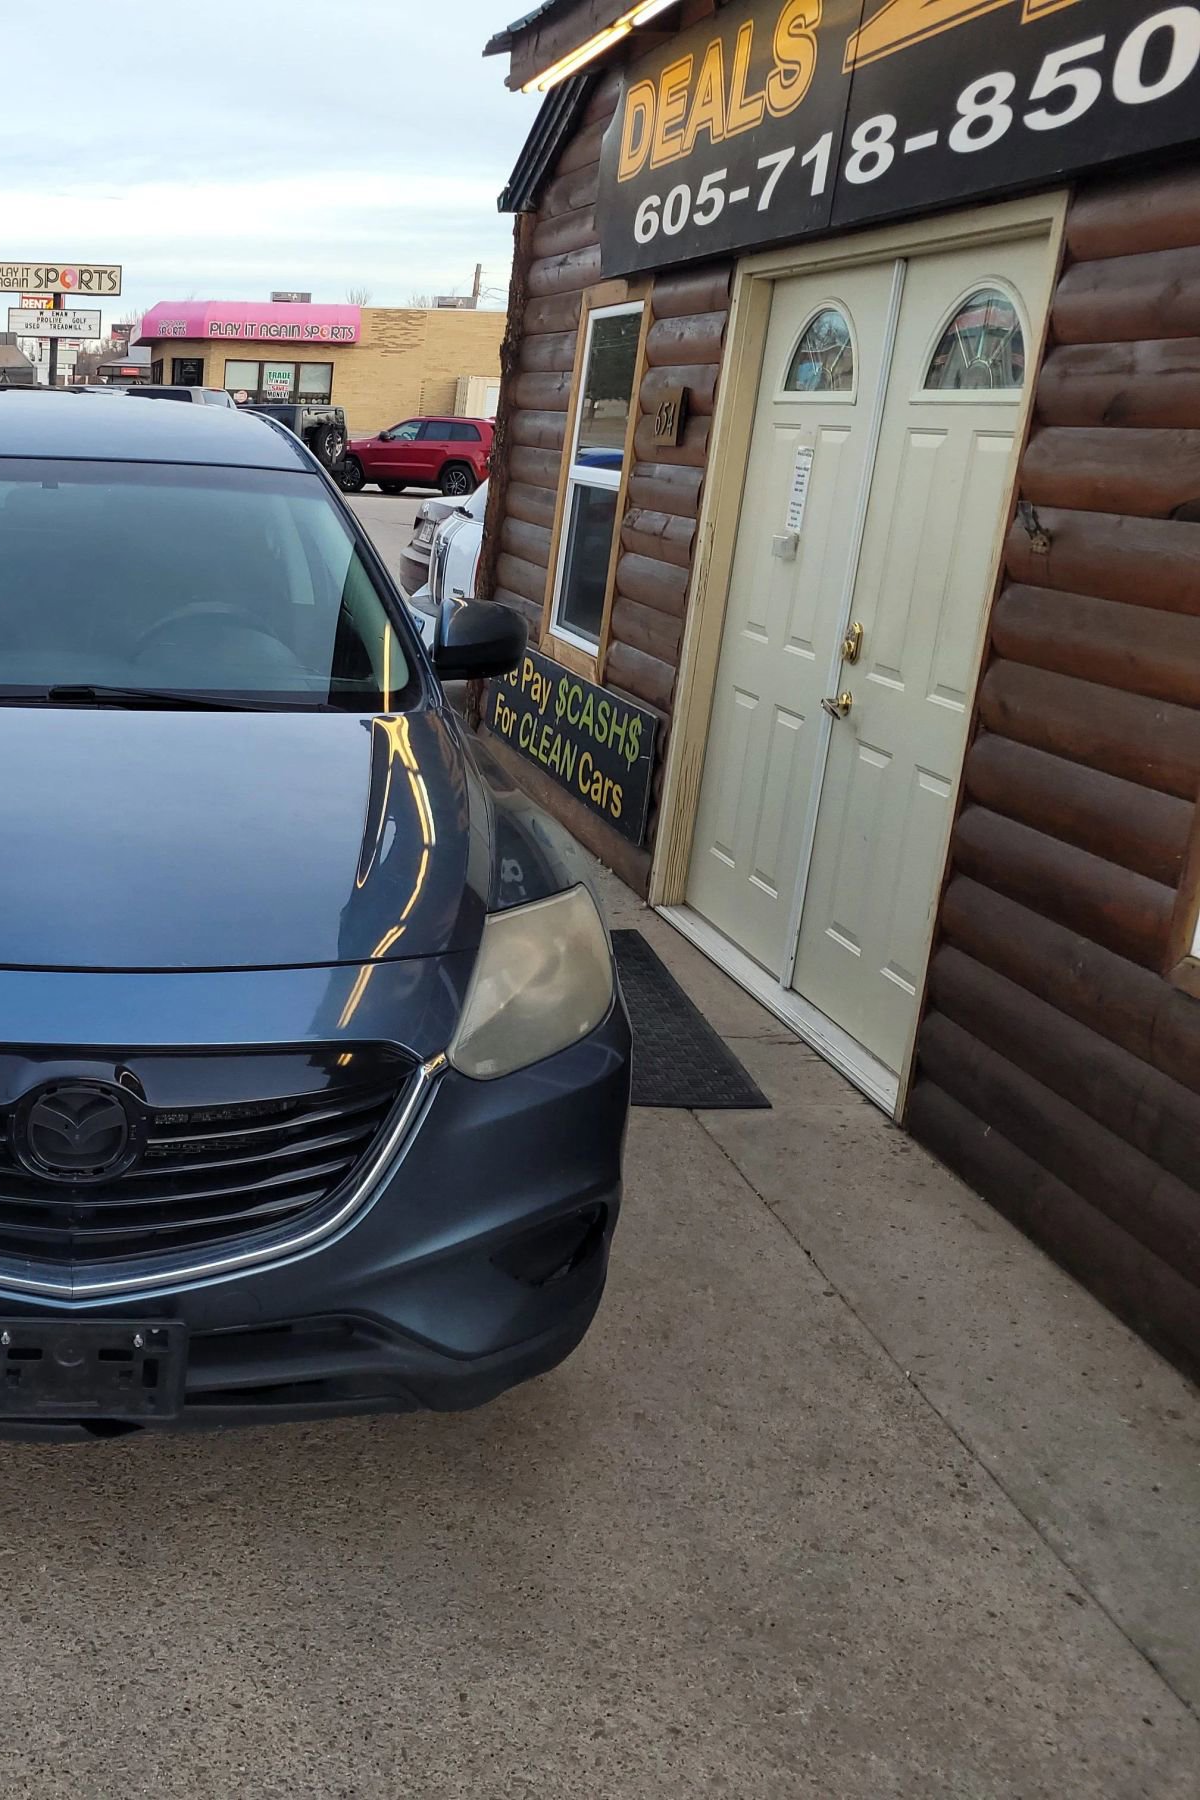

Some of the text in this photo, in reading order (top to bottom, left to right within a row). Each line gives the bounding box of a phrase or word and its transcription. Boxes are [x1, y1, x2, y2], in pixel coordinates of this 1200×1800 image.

[617, 0, 822, 183] DEALS
[634, 5, 1200, 245] 605-718-850
[22, 267, 31, 277] IT
[33, 267, 117, 291] SPORTS
[158, 326, 186, 336] SPORTS
[209, 322, 355, 340] PLAY IT AGAIN SPORTS
[268, 371, 291, 379] TRADE
[655, 402, 676, 436] 654
[521, 657, 552, 716] Pay
[555, 673, 642, 772] $CASH$
[494, 692, 623, 819] For CLEAN Cars
